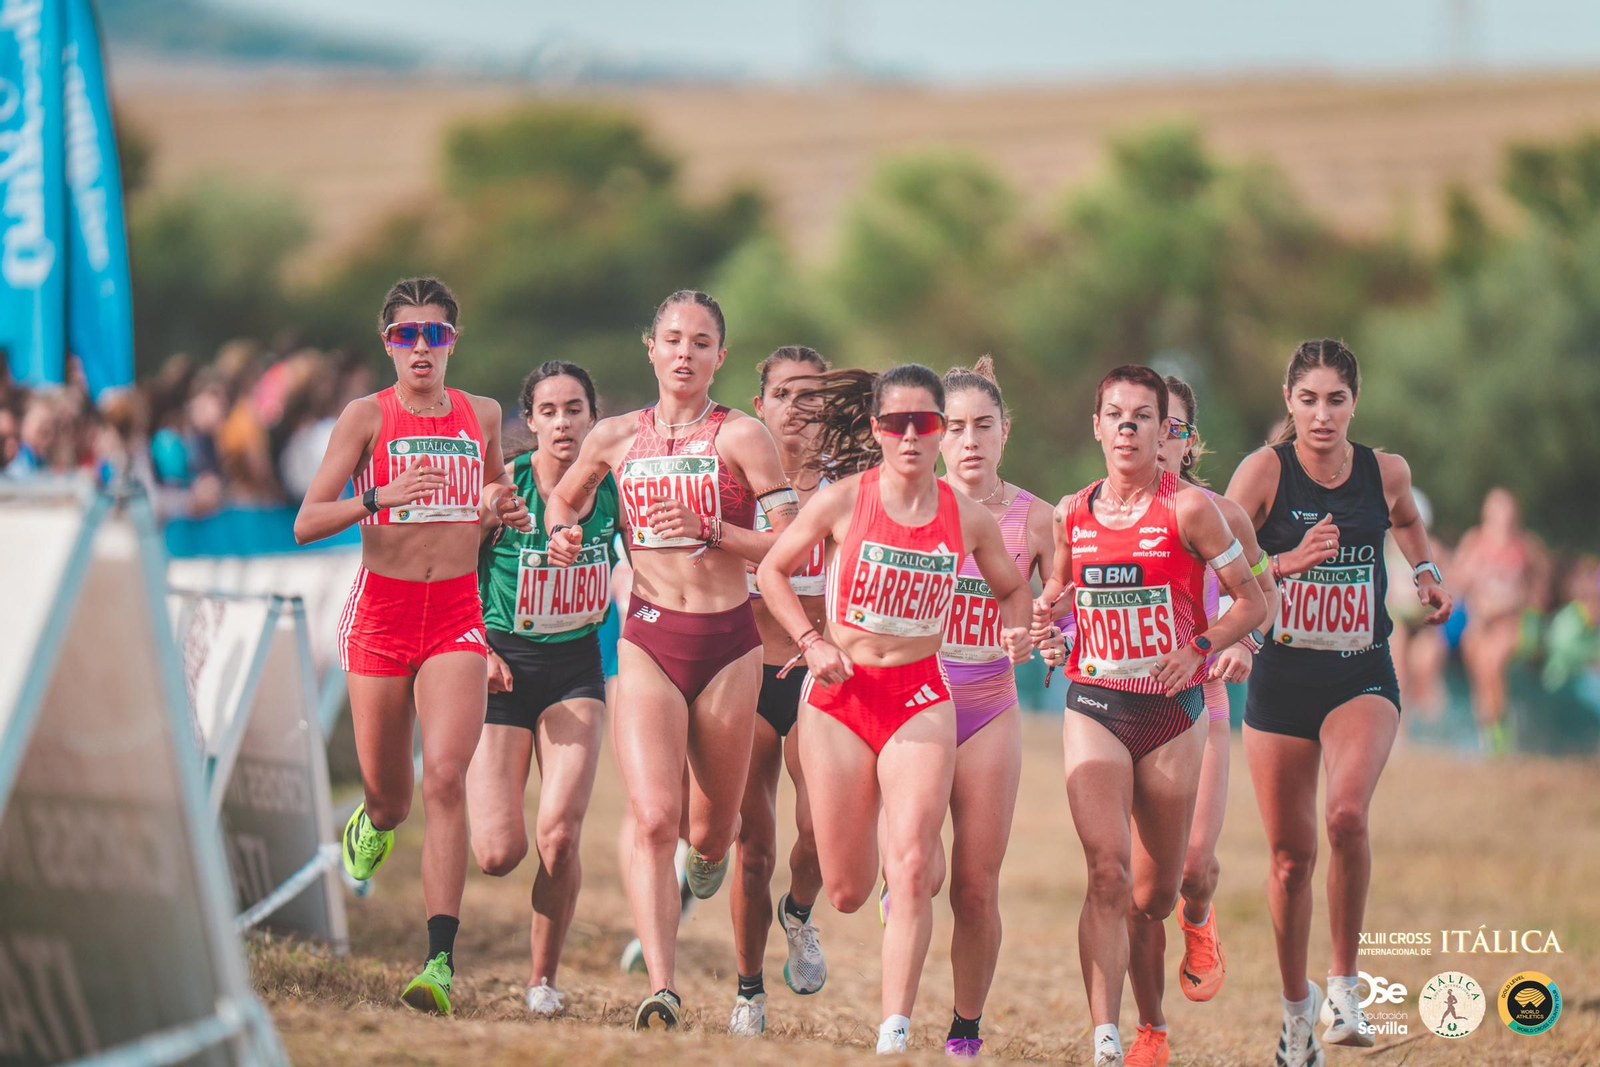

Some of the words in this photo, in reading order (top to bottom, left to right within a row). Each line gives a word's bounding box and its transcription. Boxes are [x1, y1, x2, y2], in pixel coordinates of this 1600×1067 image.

[416, 440, 459, 451] ITÁLICA
[889, 552, 936, 570] ITÁLICA
[1132, 550, 1171, 558] emteSPORT
[1105, 566, 1138, 584] BM
[1307, 569, 1351, 582] ITÁLICA
[517, 568, 549, 616] AIT
[550, 563, 608, 616] ALIBOU
[850, 560, 954, 621] BARREIRO
[1096, 591, 1142, 604] ITÁLICA
[1281, 581, 1370, 633] VICIOSA
[1078, 605, 1173, 661] ROBLES
